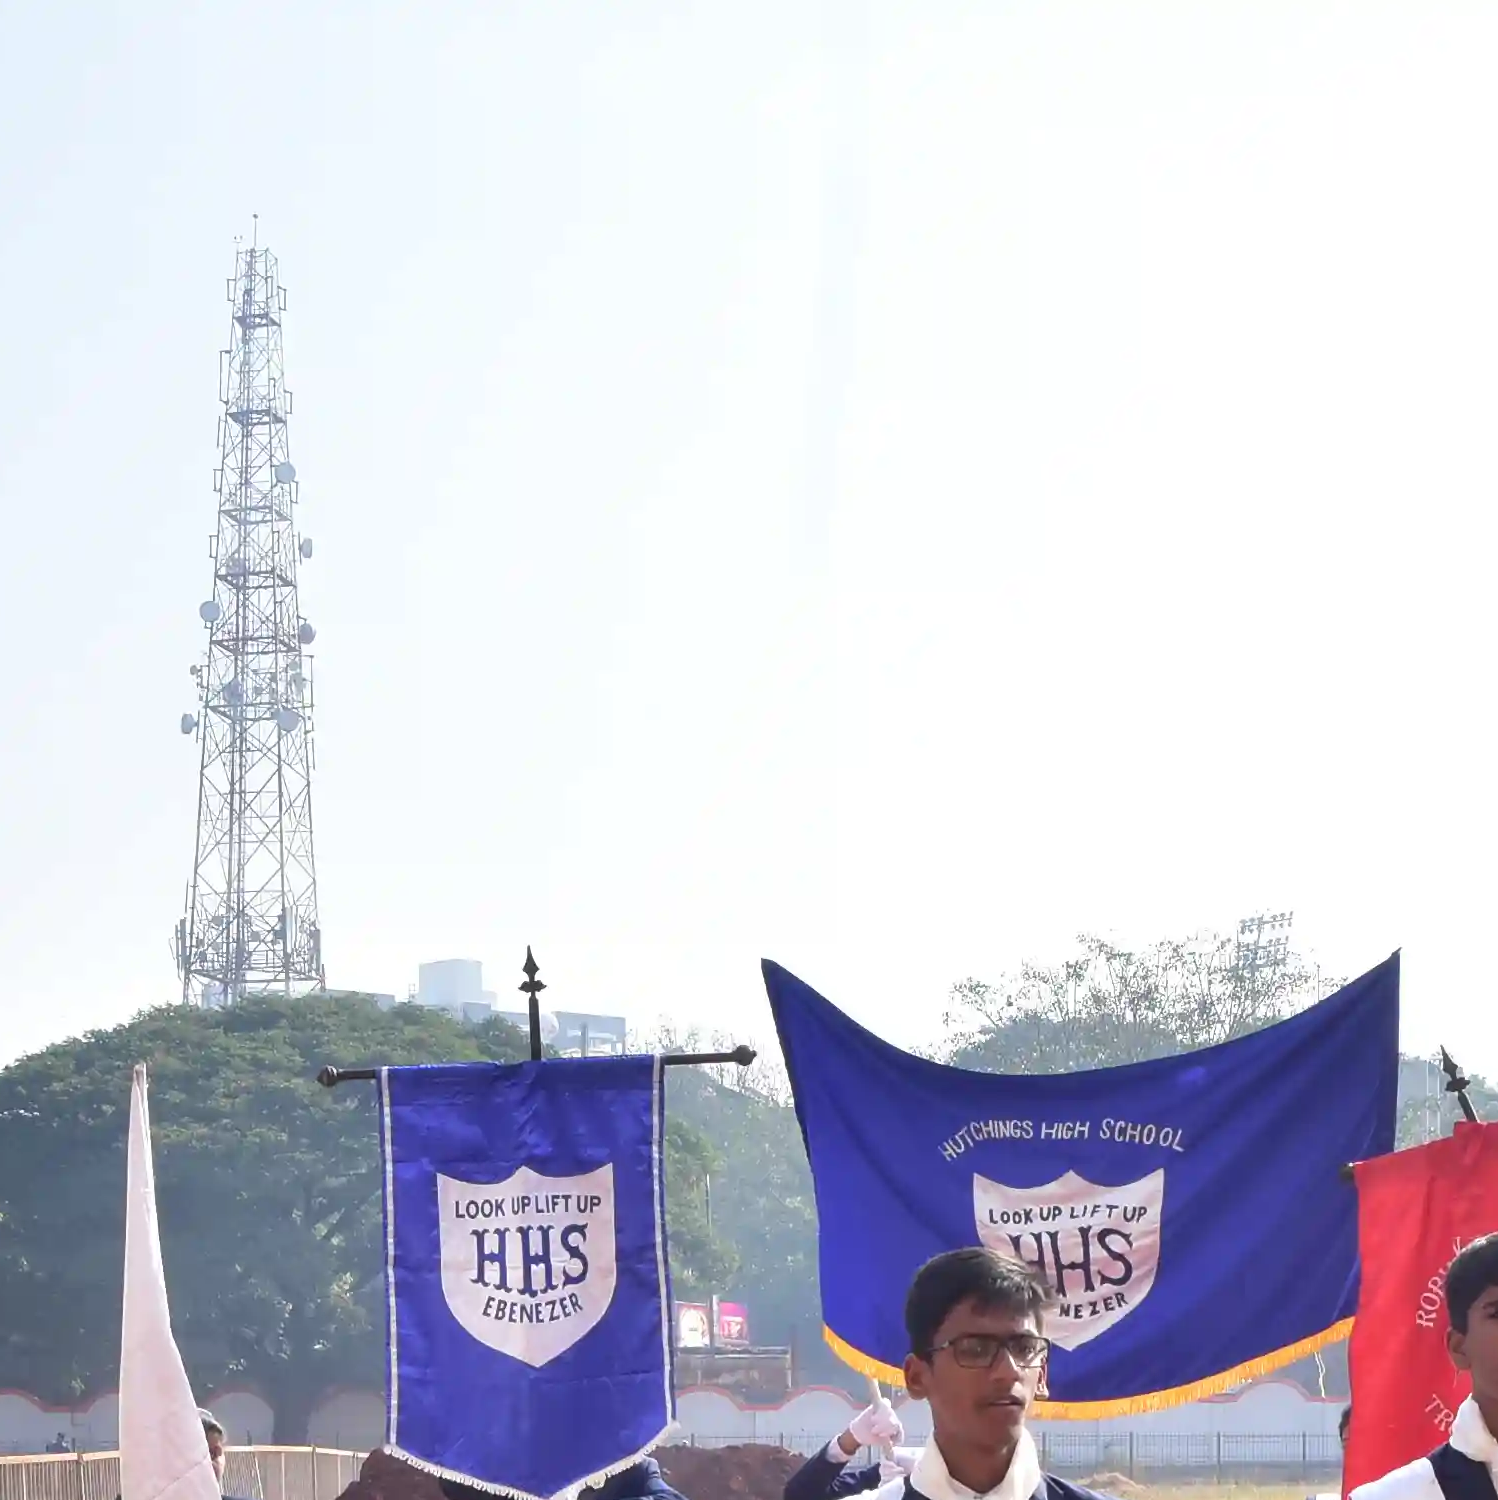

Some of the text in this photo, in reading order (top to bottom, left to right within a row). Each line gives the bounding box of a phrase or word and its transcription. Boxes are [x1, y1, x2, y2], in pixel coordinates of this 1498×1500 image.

[938, 1118, 1184, 1161] HUTCHINGS HIGH SCHOOL
[455, 1195, 602, 1219] LOOK UP LIFT UP
[989, 1204, 1147, 1224] LOOK UP LIFT UP
[469, 1222, 589, 1298] HHS
[482, 1292, 583, 1324] EBENEZER
[1059, 1292, 1129, 1319] NEZER
